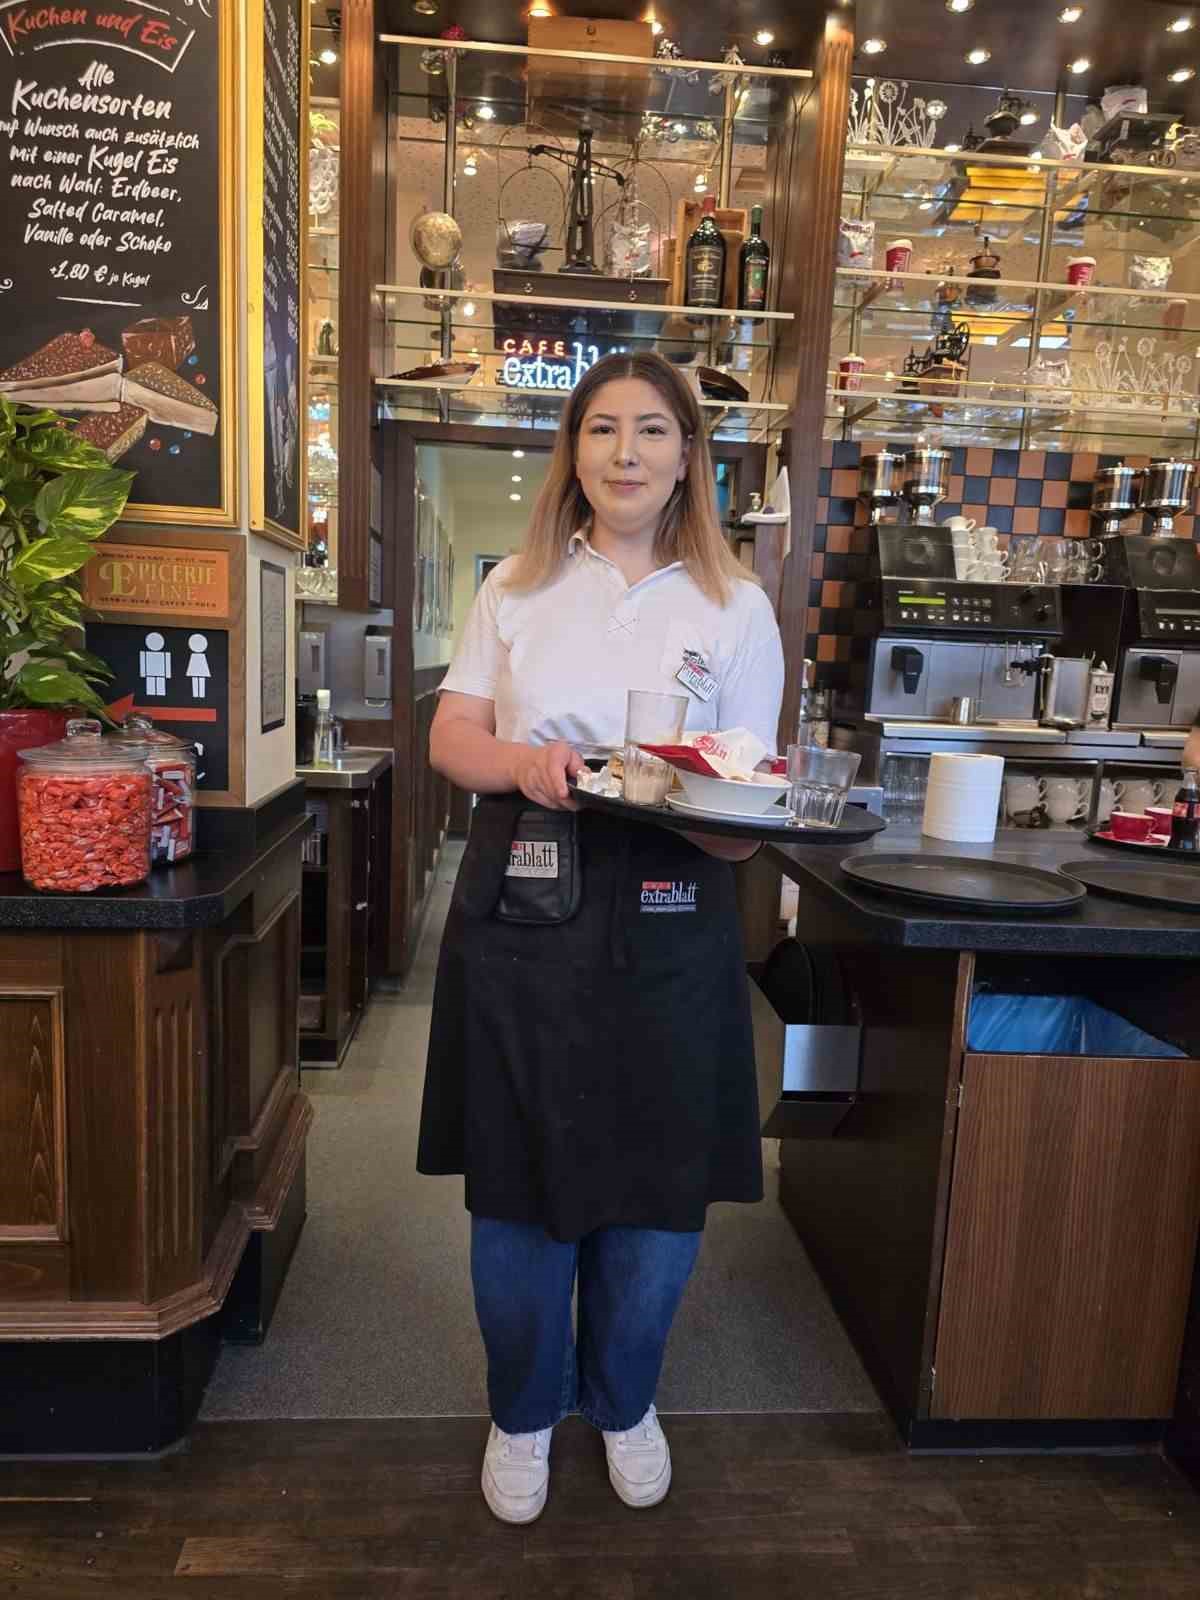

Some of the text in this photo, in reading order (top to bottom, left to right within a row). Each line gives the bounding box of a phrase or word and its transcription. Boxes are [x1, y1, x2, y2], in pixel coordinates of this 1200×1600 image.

[8, 6, 177, 50] Kuchen und Eis
[77, 60, 115, 90] Alle
[12, 79, 172, 120] Kuchensorten
[24, 116, 80, 139] Wunsch
[84, 128, 119, 142] auch
[124, 130, 200, 149] zusätzlich
[43, 151, 83, 166] einer
[88, 145, 144, 176] Kugel
[147, 149, 179, 175] Eis
[11, 172, 182, 202] nach Wahl: Erdbeer,
[28, 198, 165, 228] Salted Caramel,
[24, 223, 172, 254] Vanille oder Schoko
[50, 260, 151, 287] +1,80 € je Kugel
[640, 880, 699, 904] extrablatt
